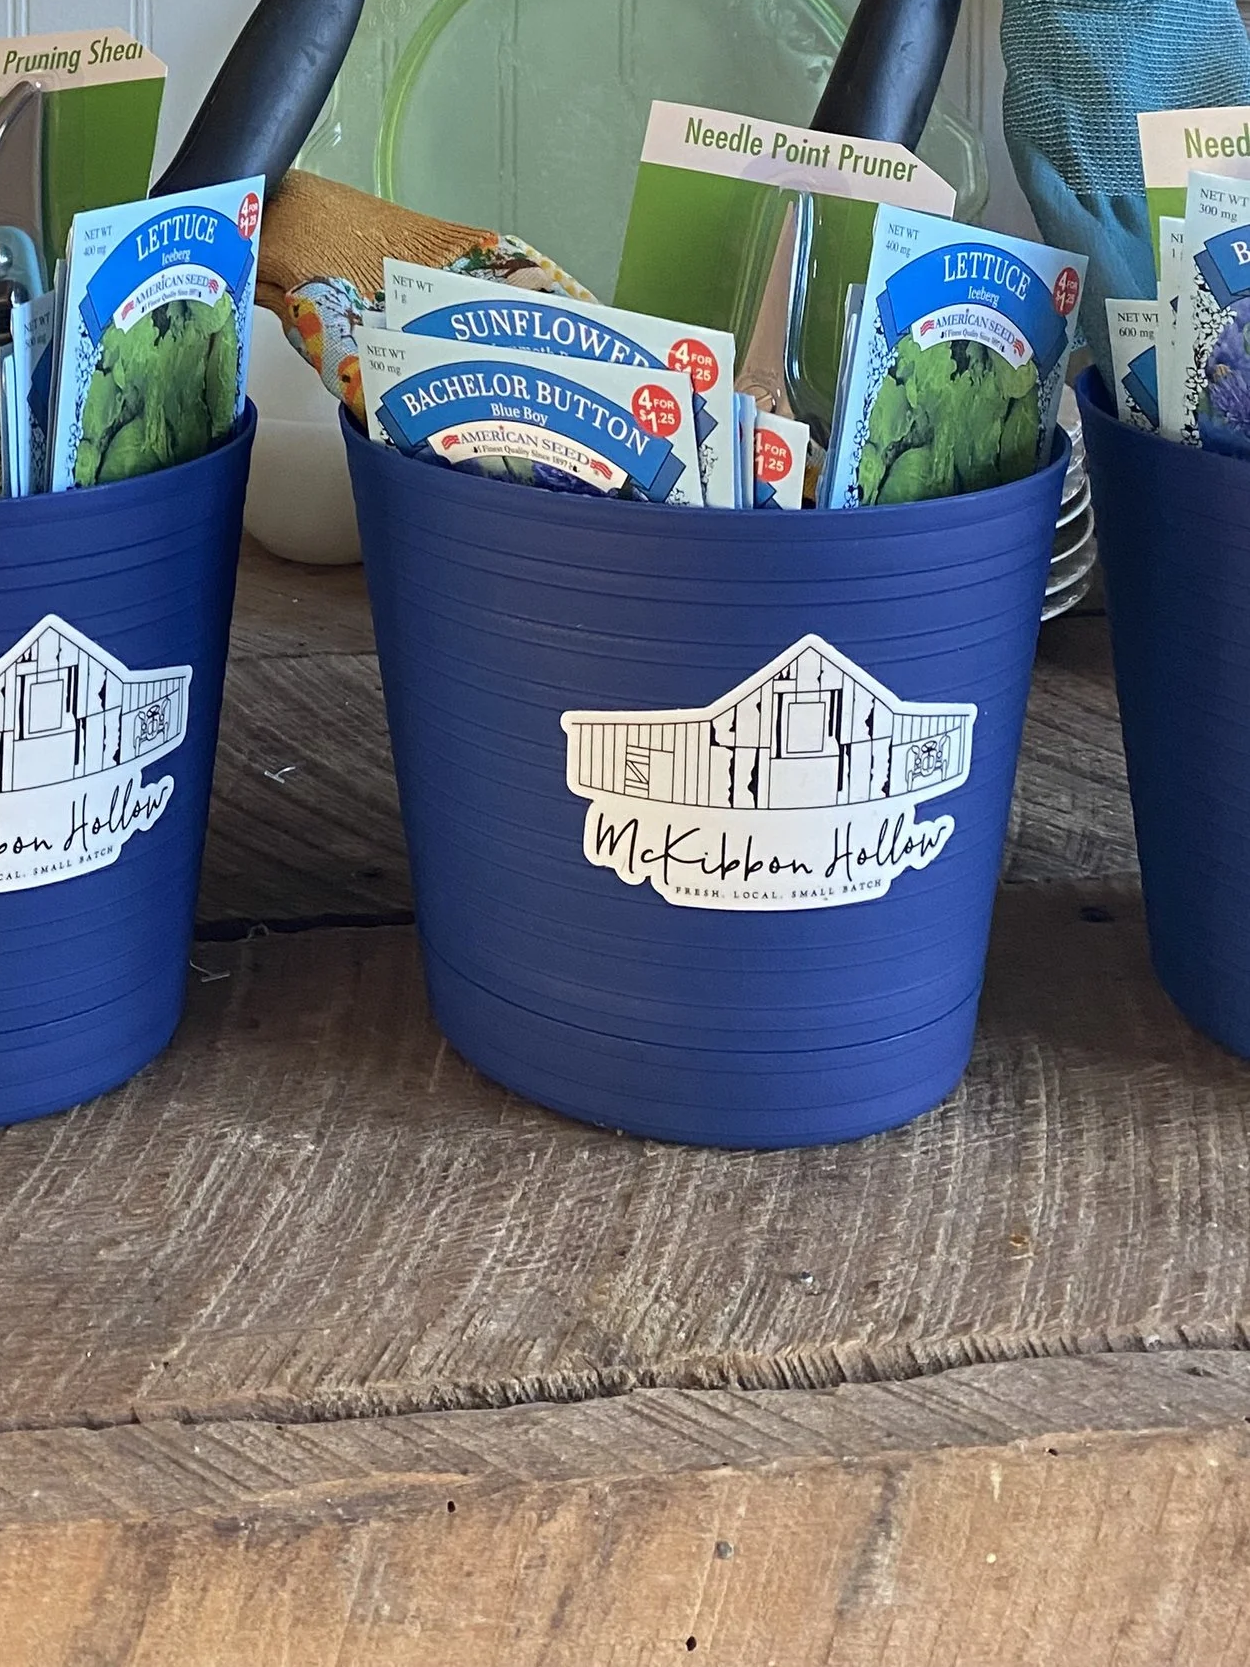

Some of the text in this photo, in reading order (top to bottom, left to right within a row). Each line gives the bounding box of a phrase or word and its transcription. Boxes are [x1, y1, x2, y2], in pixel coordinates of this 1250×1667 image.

[3, 46, 81, 74] Pruning
[684, 117, 917, 182] Needle Point Pruner
[241, 197, 249, 217] 4
[1200, 188, 1248, 207] NET WT
[1199, 203, 1238, 223] 300 mg
[84, 225, 112, 241] NET WT
[135, 213, 217, 261] LETTUCE
[888, 223, 919, 240] NET WT
[161, 248, 191, 267] Iceberg
[392, 274, 434, 293] NET WT
[943, 251, 1030, 301] LETTUCE
[1059, 271, 1067, 291] 4
[135, 274, 184, 307] AMERICAN
[185, 274, 209, 287] SEED
[967, 285, 1000, 308] Iceberg
[936, 312, 989, 329] AMERICAN
[989, 320, 1015, 345] SEED
[1118, 312, 1139, 323] NET
[1119, 327, 1155, 340] 600 mg
[367, 344, 406, 360] NET WT
[675, 342, 712, 366] 4 FOR
[369, 359, 401, 376] 300 mg
[638, 389, 674, 412] 4 FOR
[401, 374, 650, 456] BACHELOR BUTTON
[490, 402, 549, 426] Blue Boy
[639, 410, 675, 432] $1.25
[460, 429, 590, 465] AMERICAN SEED
[764, 443, 787, 458] FOR
[755, 454, 785, 476] 1.25
[63, 777, 169, 853] Hollow
[595, 812, 947, 886] McKibbon Hollow
[33, 860, 72, 876] SMALL
[78, 845, 115, 864] BATCH
[791, 886, 834, 899] SMALL
[842, 879, 882, 895] BATCH
